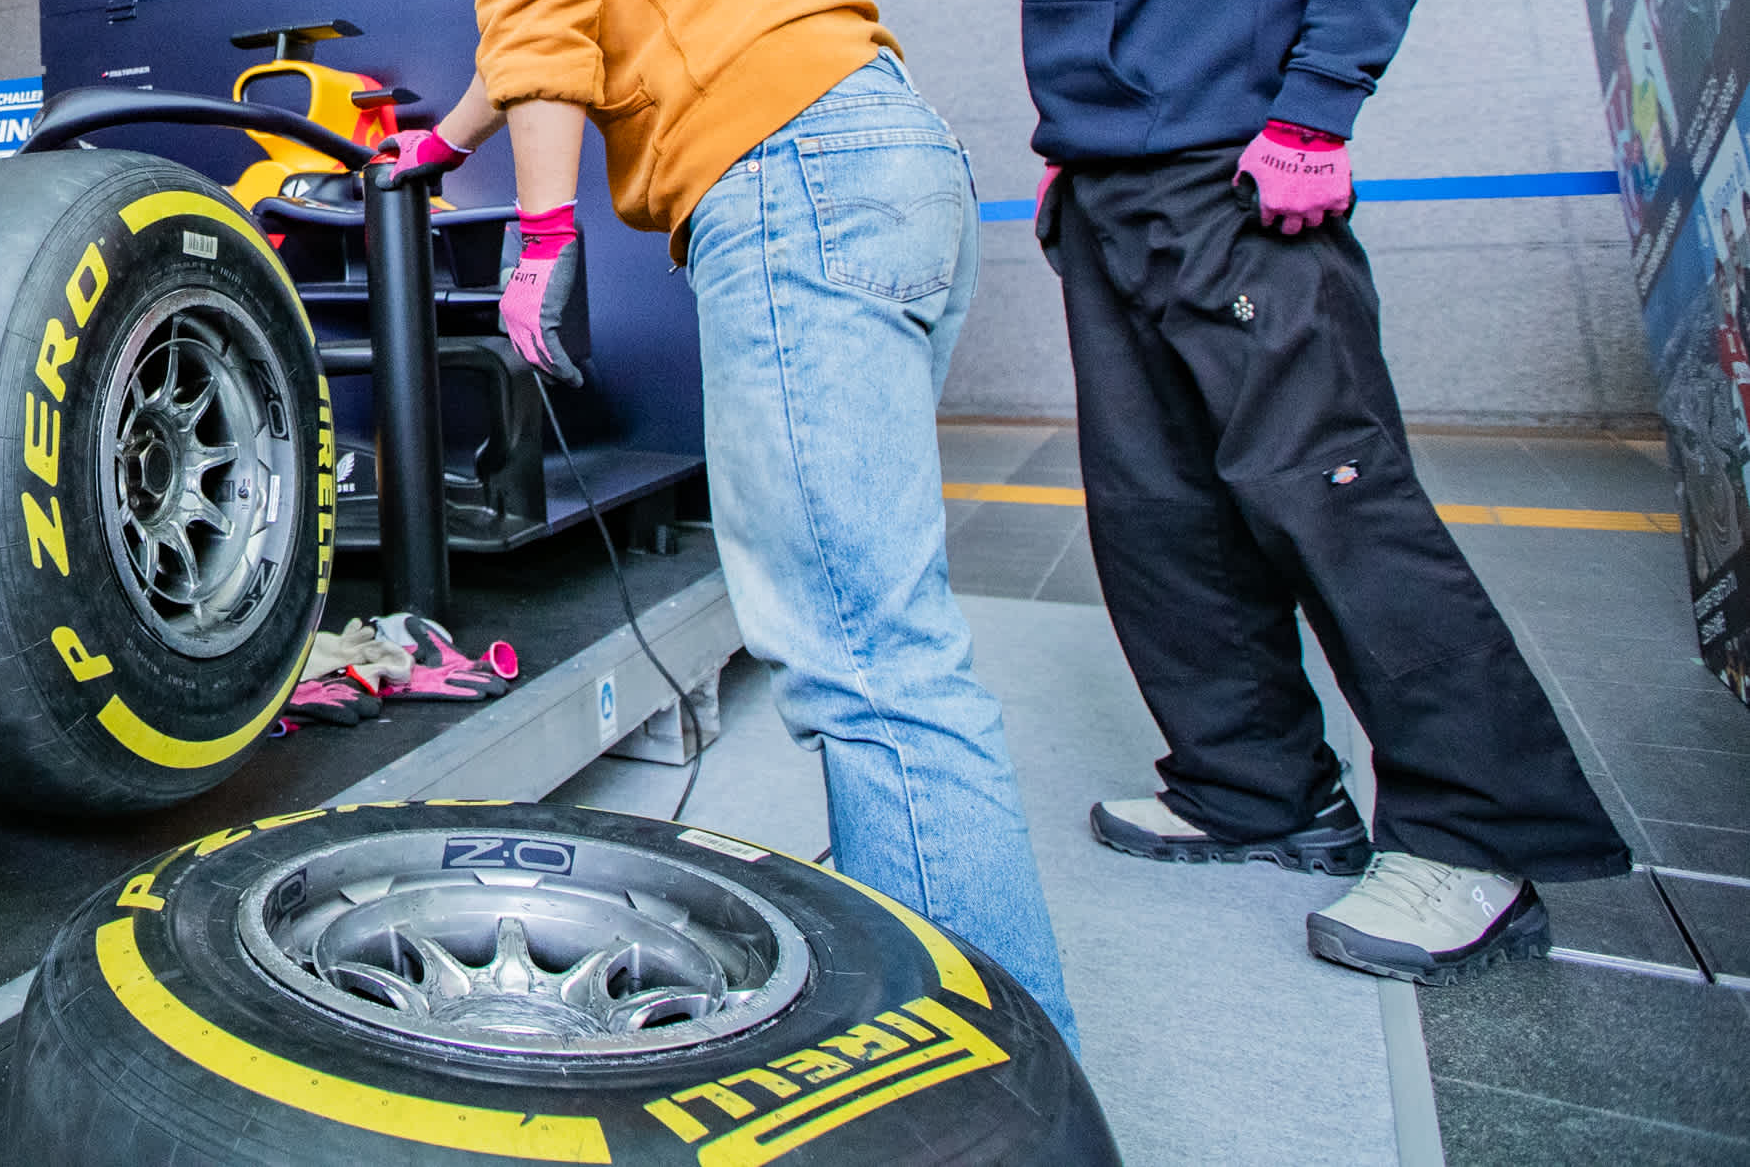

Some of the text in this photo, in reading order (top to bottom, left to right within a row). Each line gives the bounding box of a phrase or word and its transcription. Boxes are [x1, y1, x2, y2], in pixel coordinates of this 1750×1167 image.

[22, 240, 111, 577] ZERO
[51, 626, 113, 683] P
[116, 873, 166, 911] P
[643, 996, 1010, 1167] PIRELLI
